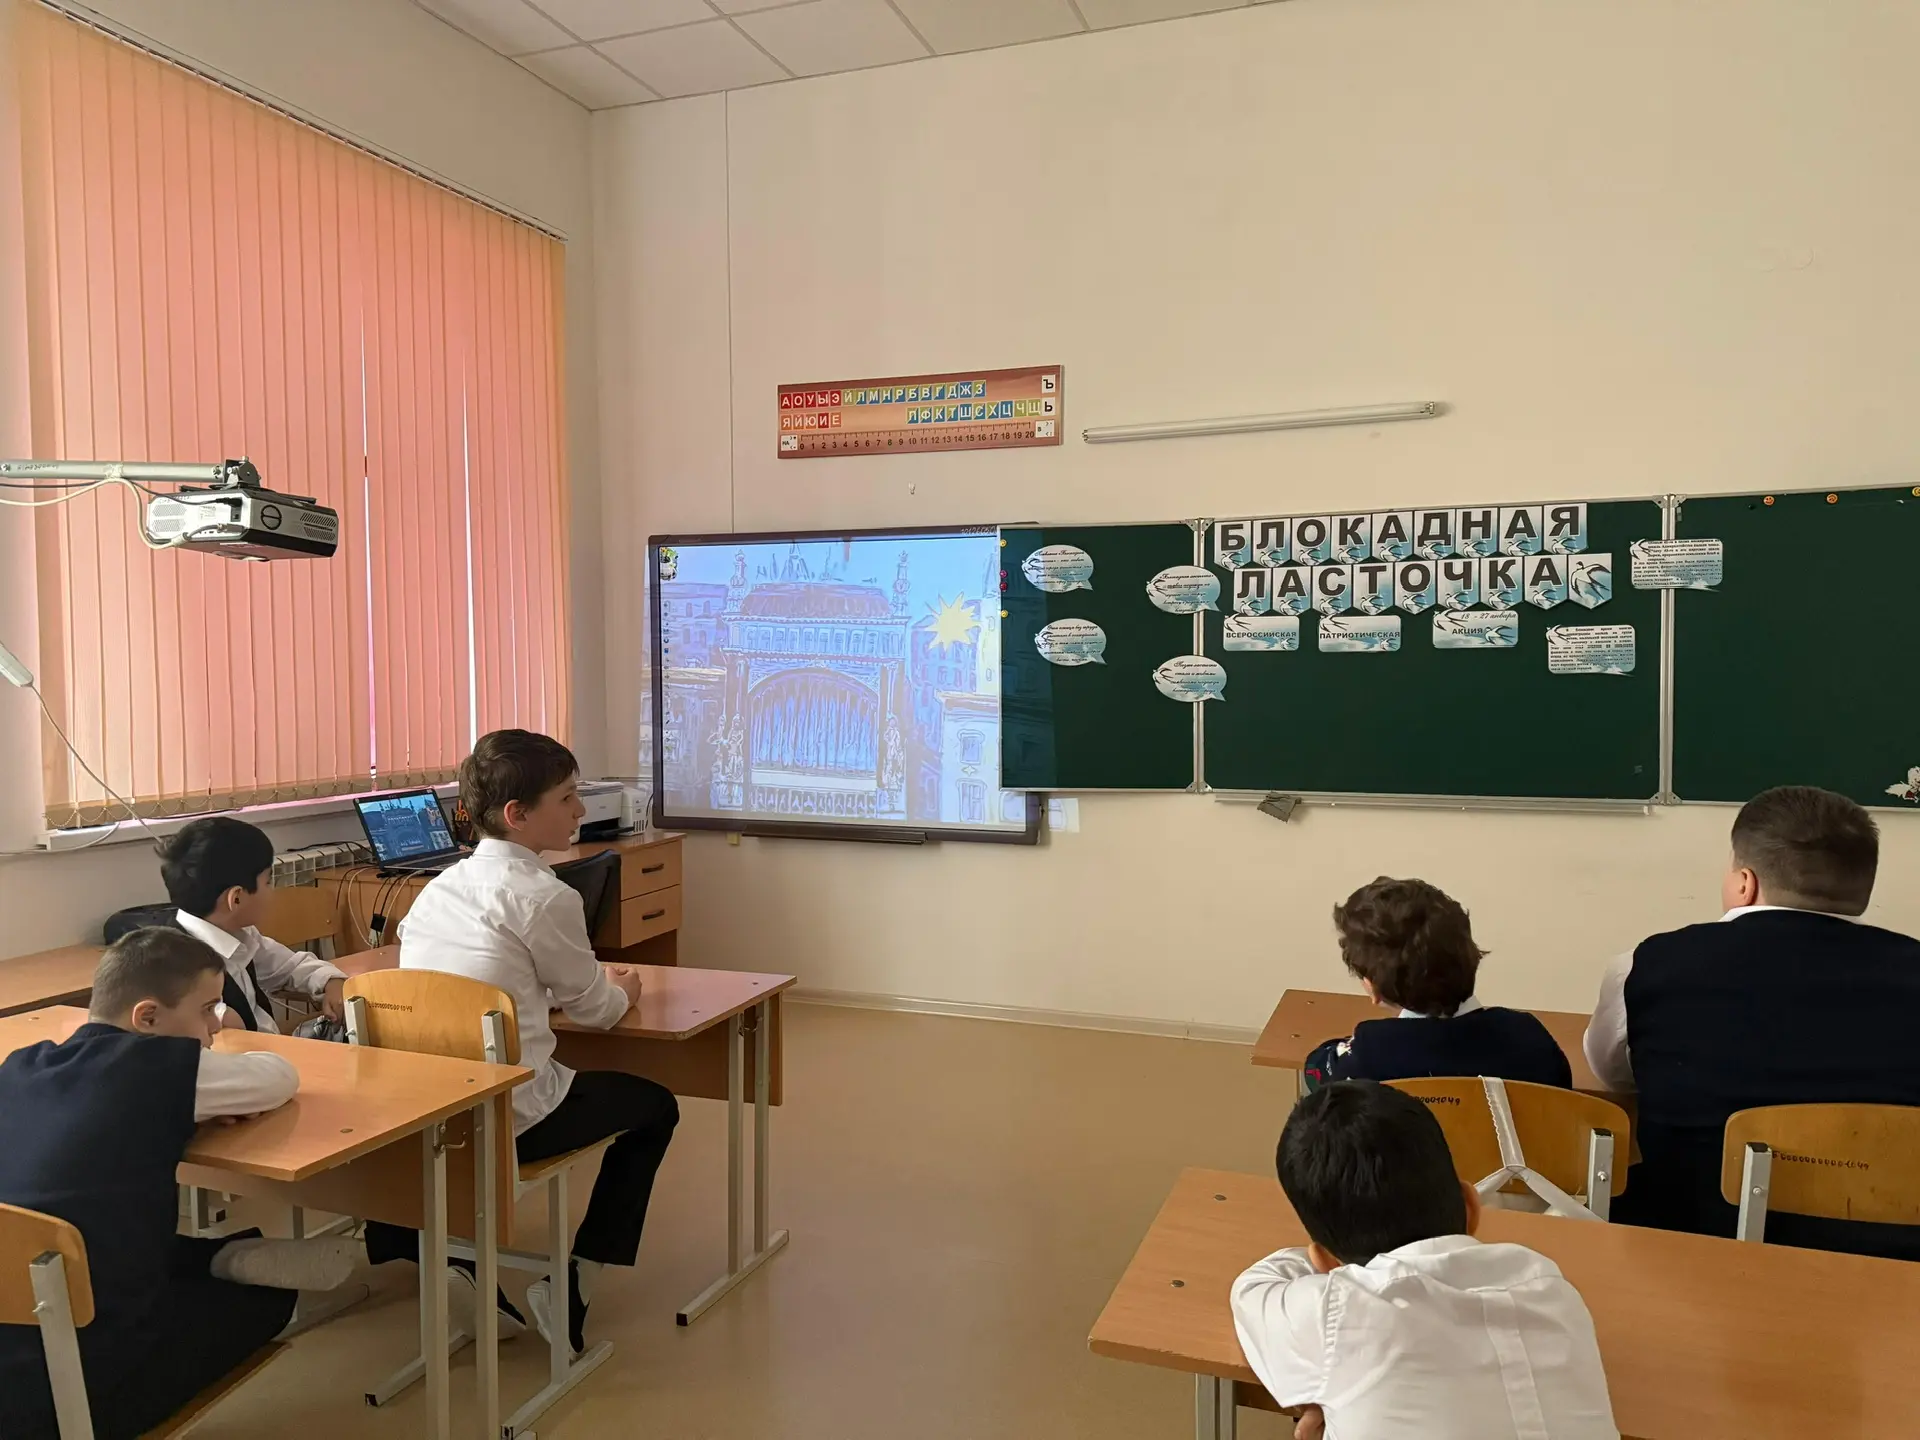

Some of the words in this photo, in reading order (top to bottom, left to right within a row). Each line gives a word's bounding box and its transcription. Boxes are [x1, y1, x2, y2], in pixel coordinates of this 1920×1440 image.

[1220, 506, 1579, 552] БЛОКАДНАЯ
[1236, 557, 1563, 598] ЛАСТОЧКА
[1319, 631, 1400, 639] ПАТРИОТИЧЕСКАЯ
